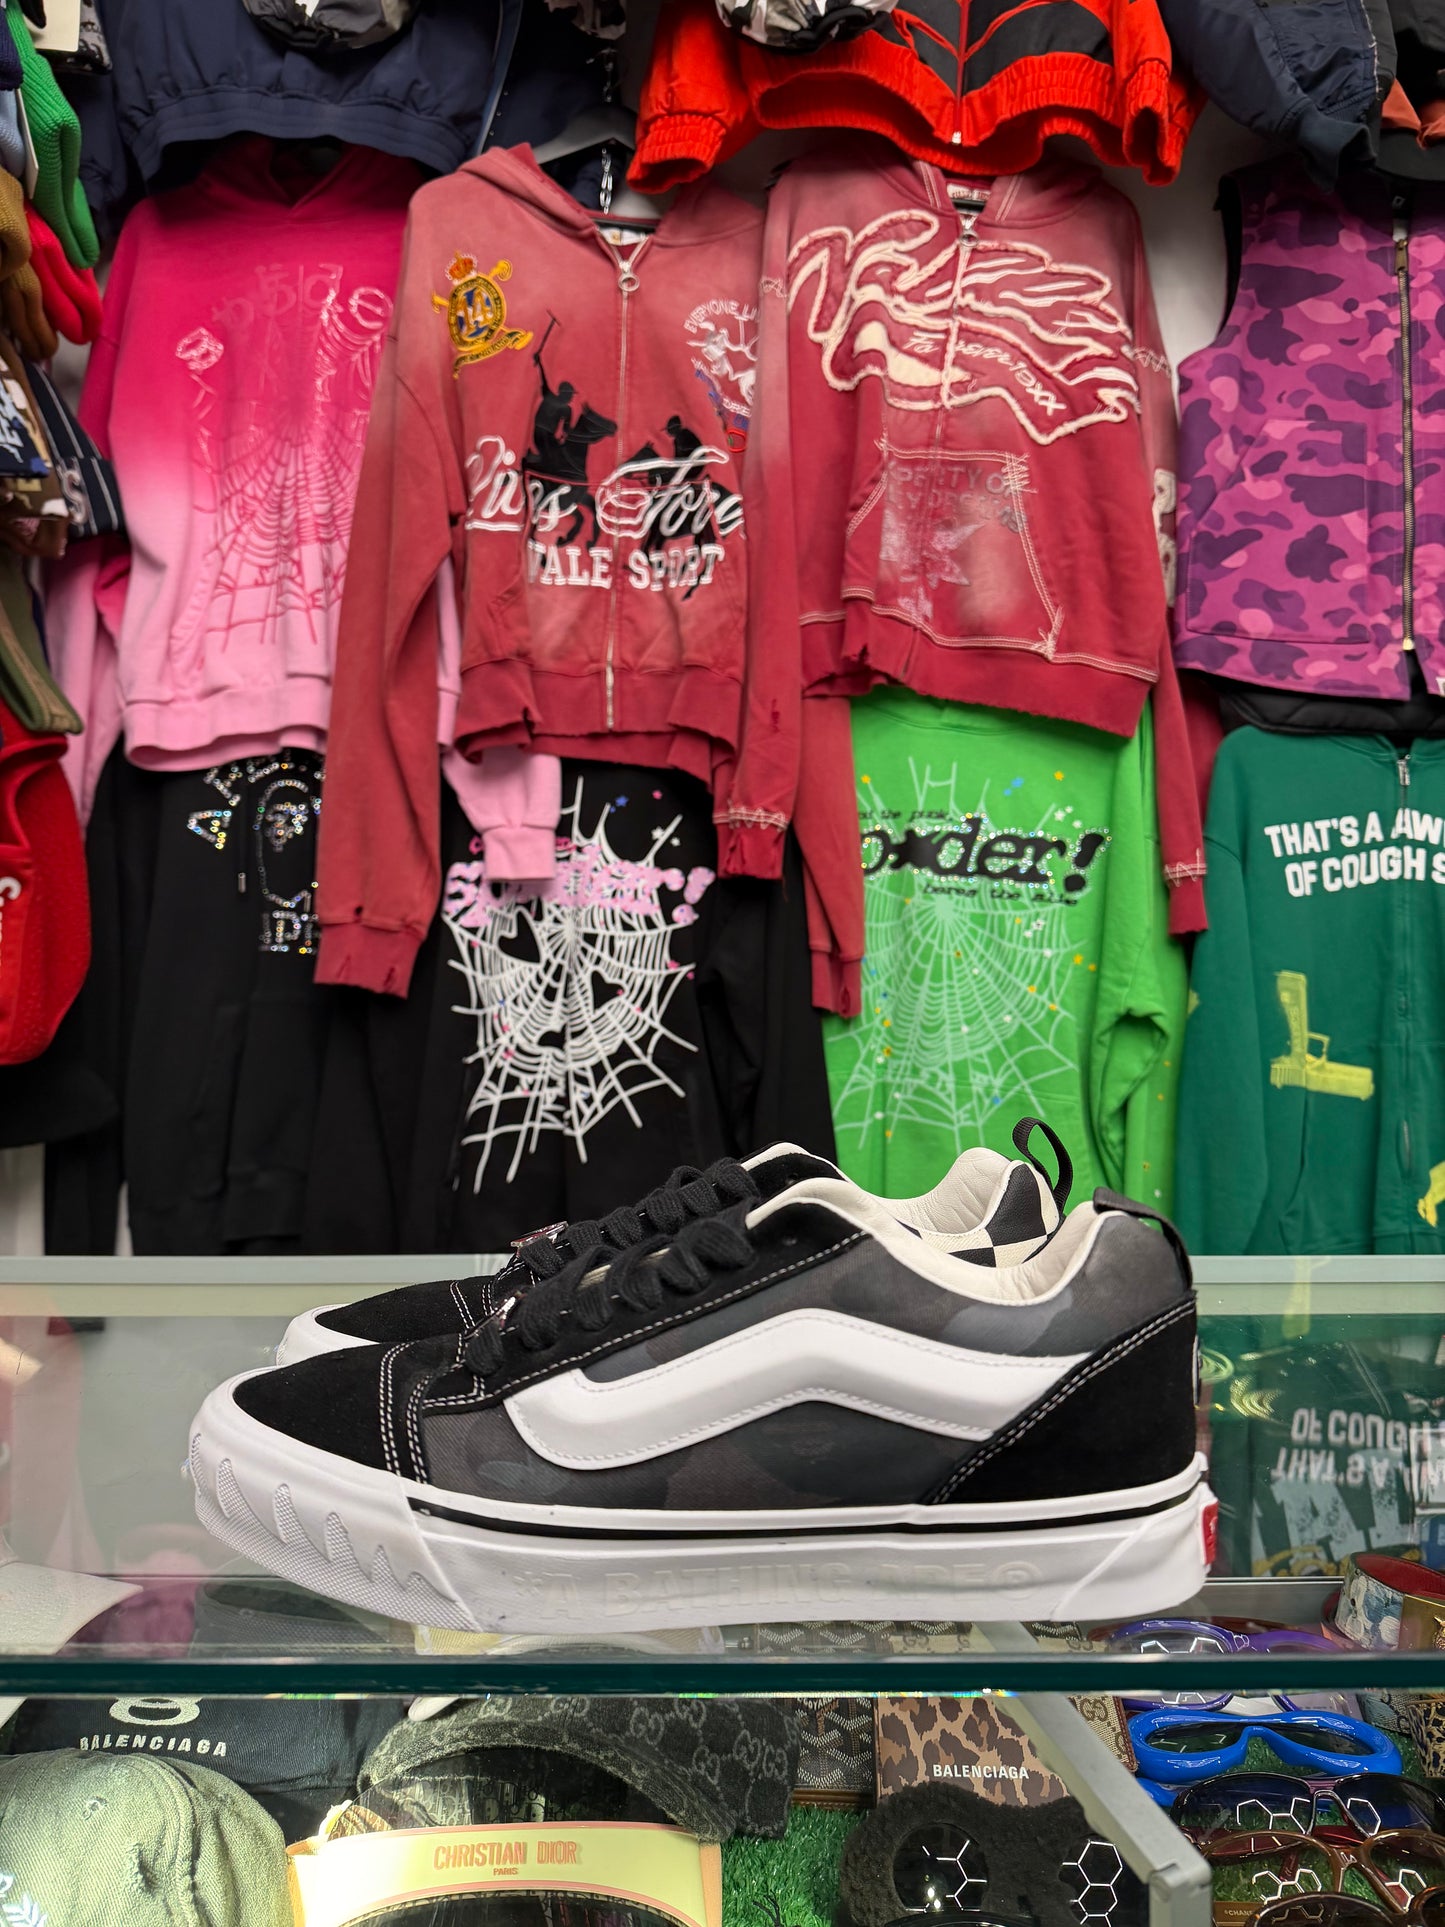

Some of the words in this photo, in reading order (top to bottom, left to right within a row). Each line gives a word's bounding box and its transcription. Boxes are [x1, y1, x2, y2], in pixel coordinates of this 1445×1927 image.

[1264, 815, 1360, 858] THAT'S
[1363, 811, 1385, 844] A
[1390, 808, 1445, 849] AW
[1285, 860, 1318, 898] OF
[1321, 845, 1427, 892] COUGH
[1431, 852, 1445, 885] S
[604, 1562, 851, 1618] BATHING
[79, 1733, 228, 1758] BALENCIAGA
[932, 1763, 1030, 1780] BALENCIAGA
[433, 1840, 526, 1870] CHRISTIAN
[536, 1840, 578, 1865] DIOR
[493, 1866, 519, 1876] PARIS
